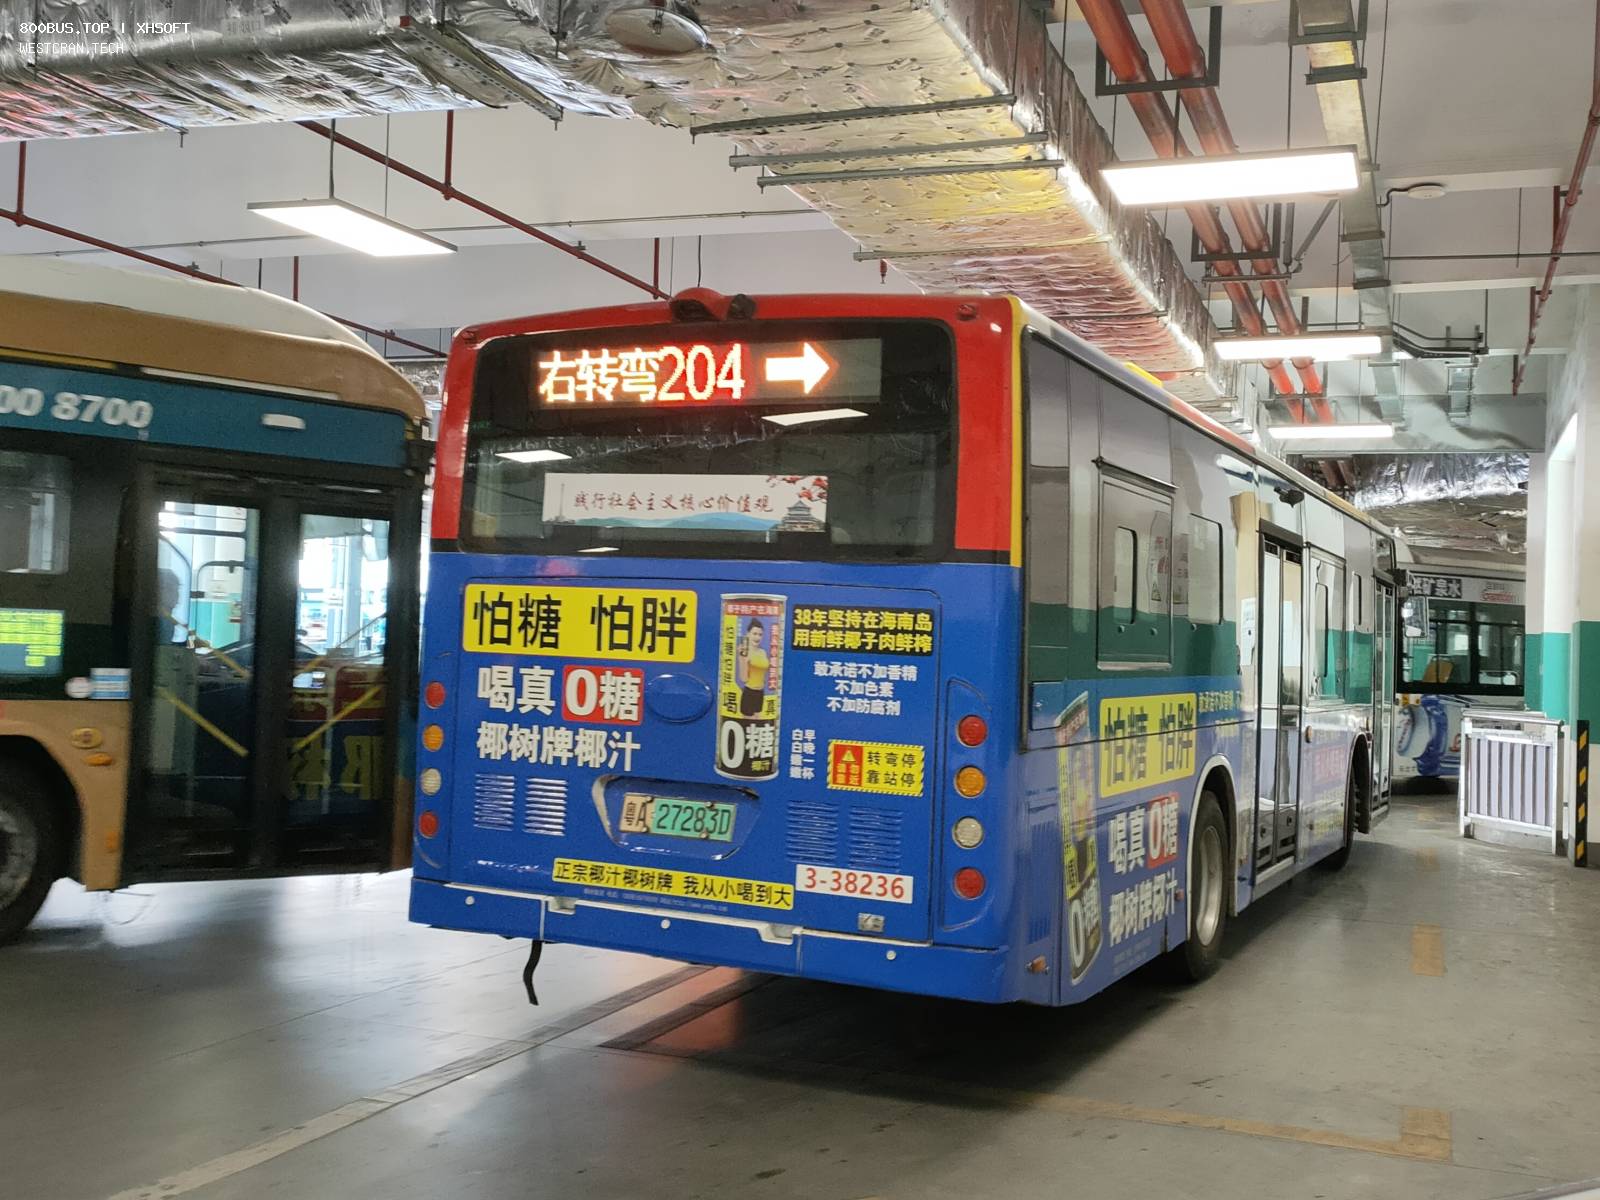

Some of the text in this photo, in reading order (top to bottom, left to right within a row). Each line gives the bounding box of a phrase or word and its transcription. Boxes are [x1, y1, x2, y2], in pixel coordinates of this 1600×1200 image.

[51, 391, 154, 428] 8700
[574, 489, 774, 514] 践行社会主义核心价值观
[473, 590, 687, 656] 怕糖 怕胖
[793, 608, 933, 632] 38年坚持在海南岛
[793, 629, 933, 654] 用新鲜椰子肉鲜榨
[814, 660, 918, 681] 敢承诺不加香精
[835, 679, 894, 698] 不加色素
[827, 697, 901, 716] 不加防腐剂
[476, 721, 641, 772] 椰树牌椰汁
[721, 719, 775, 770] 0糖
[1104, 706, 1149, 787] 怕糖
[867, 751, 917, 769] 转弯停
[866, 769, 916, 788] 靠站停
[554, 860, 673, 891] 正宗椰汁椰树牌
[683, 875, 793, 907] 我从小喝到大
[804, 866, 904, 899] 3-38236
